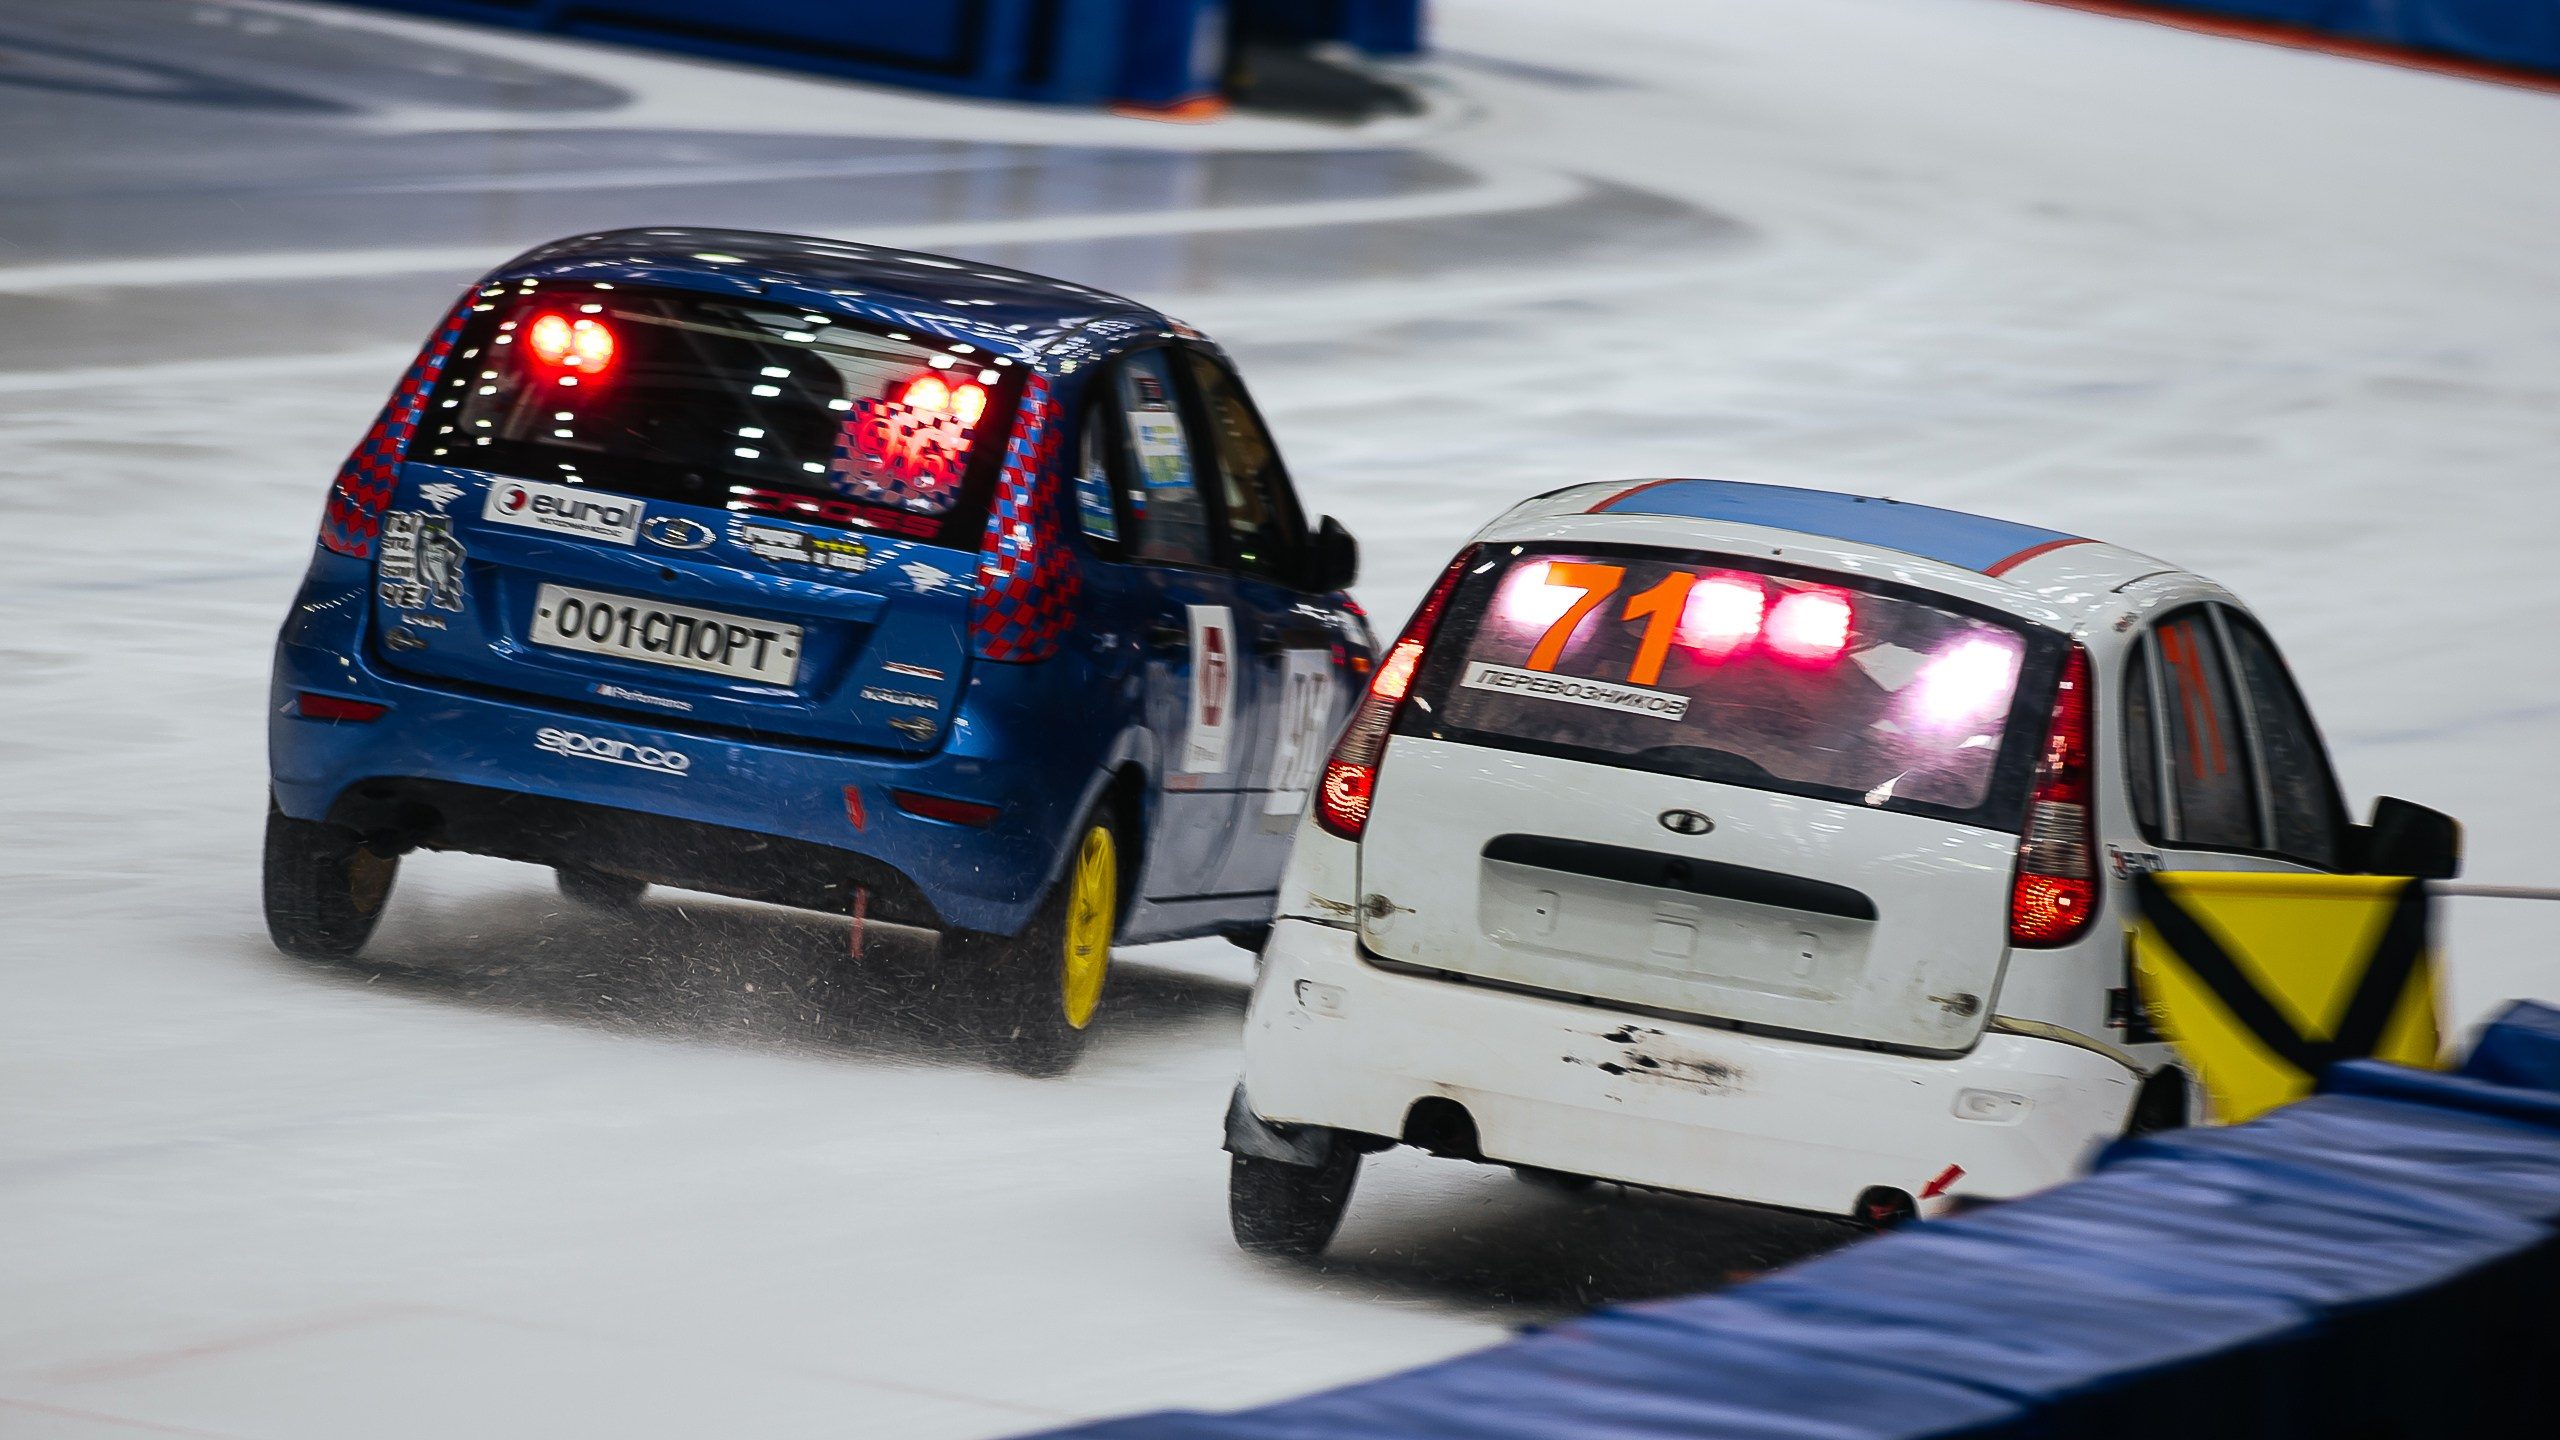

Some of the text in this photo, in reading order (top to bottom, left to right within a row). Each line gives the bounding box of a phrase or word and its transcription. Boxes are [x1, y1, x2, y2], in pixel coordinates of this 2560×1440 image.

[530, 494, 638, 529] eurol
[732, 487, 943, 538] CROSS
[1525, 561, 1697, 686] 71
[1476, 669, 1688, 715] ПЕРЕВОЗНИКОВ
[2158, 619, 2227, 779] 71
[534, 727, 691, 774] sparco
